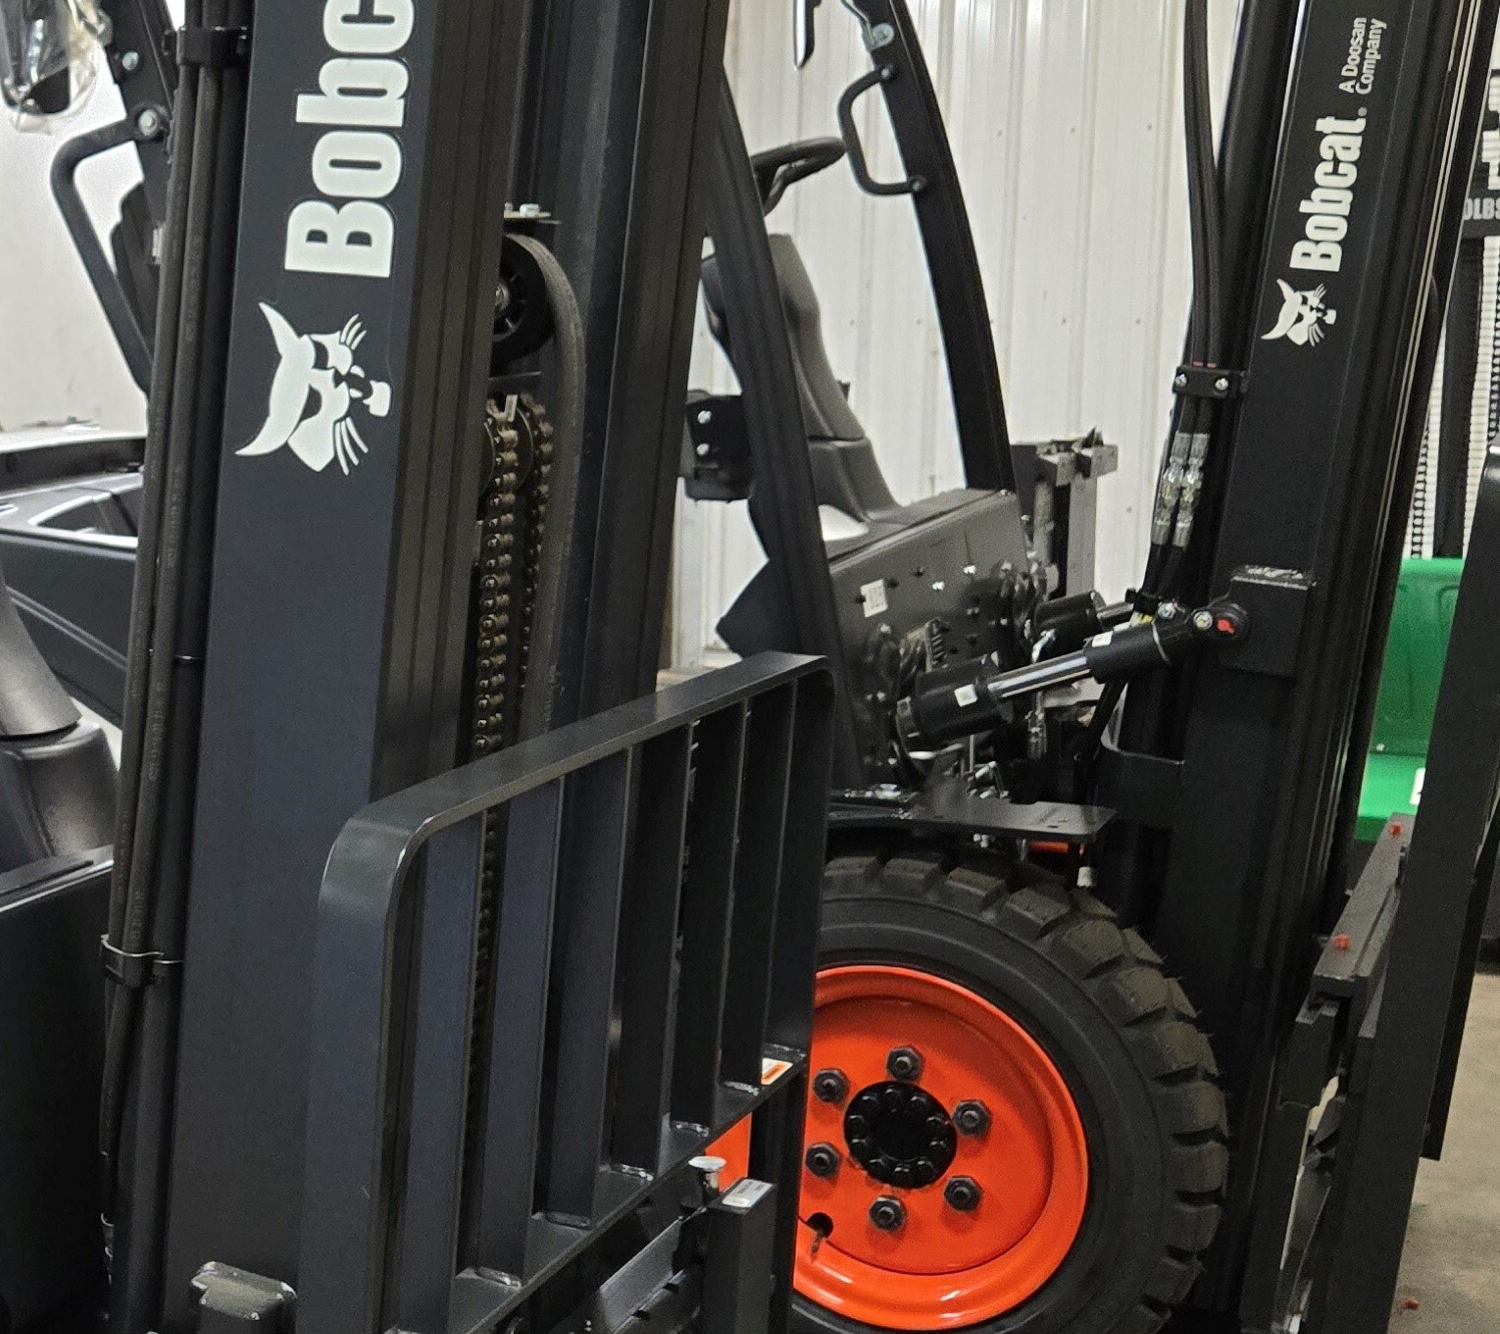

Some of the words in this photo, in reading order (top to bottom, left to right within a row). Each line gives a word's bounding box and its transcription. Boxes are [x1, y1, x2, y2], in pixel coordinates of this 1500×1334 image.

[1341, 17, 1367, 77] Doosan
[1355, 18, 1388, 95] Company
[1339, 79, 1356, 94] A
[1290, 115, 1367, 273] Bobcat
